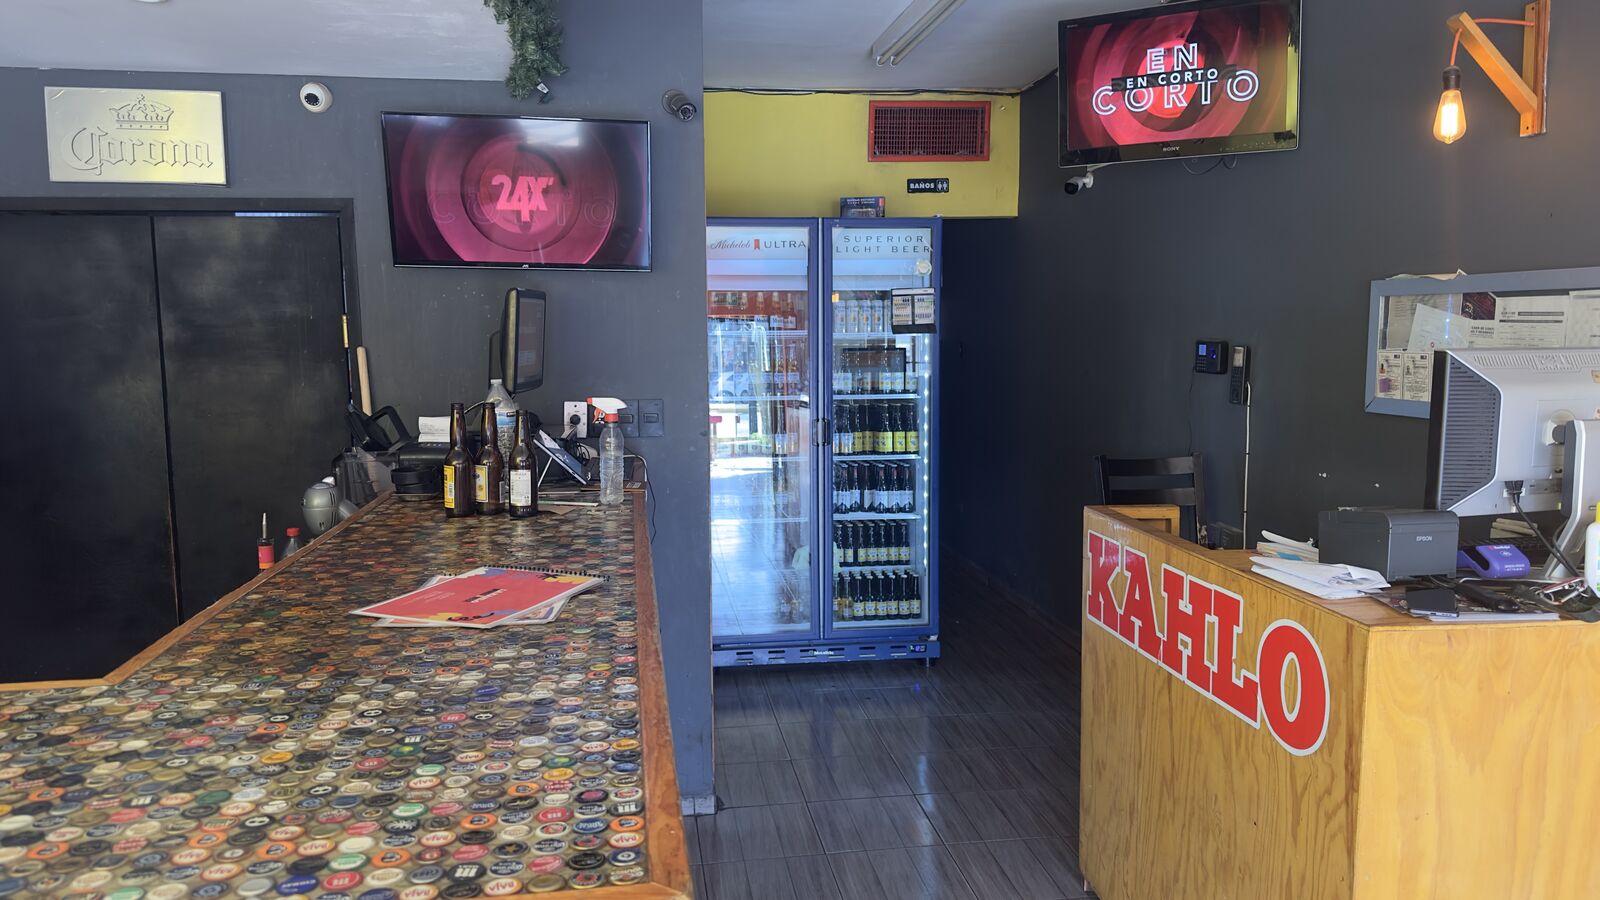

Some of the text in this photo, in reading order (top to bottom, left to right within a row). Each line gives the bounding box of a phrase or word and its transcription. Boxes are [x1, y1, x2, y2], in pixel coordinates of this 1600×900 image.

[1145, 42, 1199, 75] EN
[1126, 67, 1219, 89] EN CORTO
[1092, 69, 1260, 116] CORTO
[63, 127, 215, 176] Corona
[909, 181, 935, 189] BAÑOS
[764, 240, 807, 249] ULTRA
[843, 235, 924, 243] SUPERIOR
[1087, 529, 1330, 757] KAHLO
